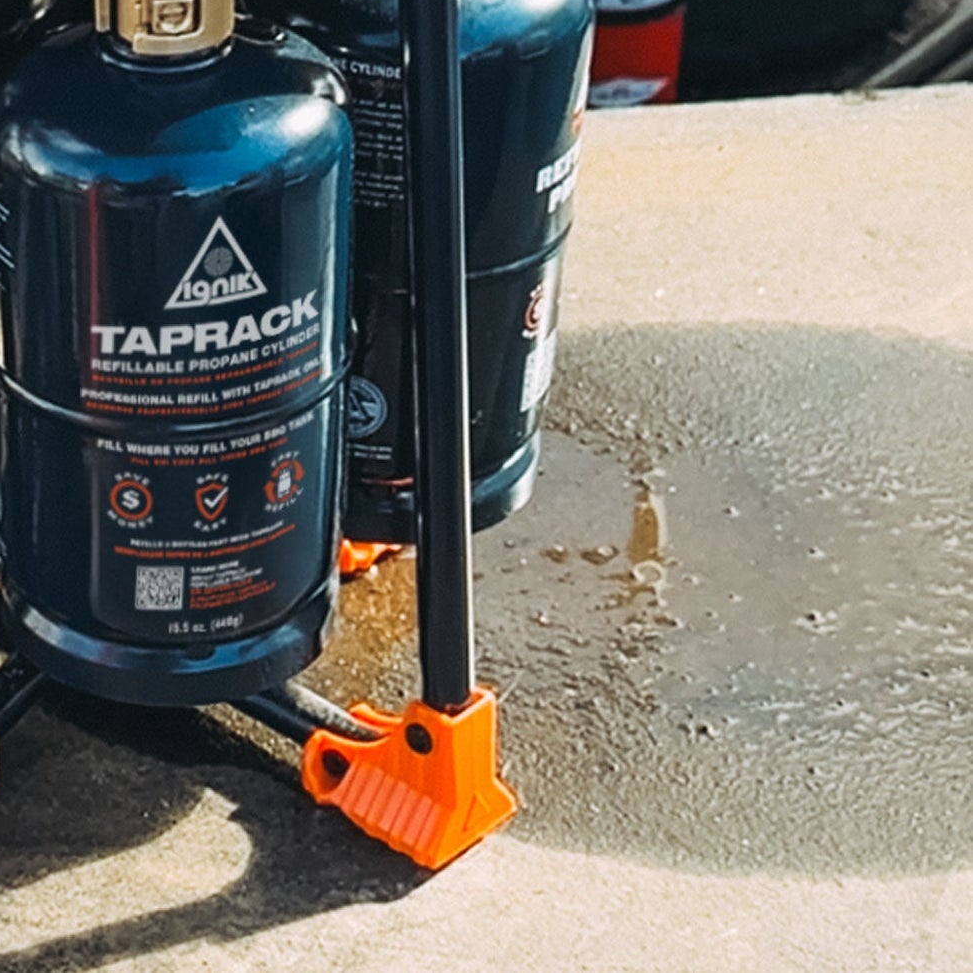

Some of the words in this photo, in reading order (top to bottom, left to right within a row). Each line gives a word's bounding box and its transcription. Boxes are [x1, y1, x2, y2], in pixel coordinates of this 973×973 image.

[349, 60, 403, 80] CYLINDE
[91, 289, 319, 356] TAPRACK
[91, 358, 185, 374] REFILLABLE
[188, 348, 259, 372] PROPANE
[261, 323, 320, 357] CYLINDER
[80, 387, 174, 405] PROFESSIONAL
[177, 392, 218, 405] REFILL
[221, 385, 251, 400] WITH
[96, 438, 124, 453] FILL
[126, 442, 171, 456] WHERE
[173, 443, 199, 456] YOU
[202, 440, 227, 455] FILL
[230, 432, 261, 450] YOUR
